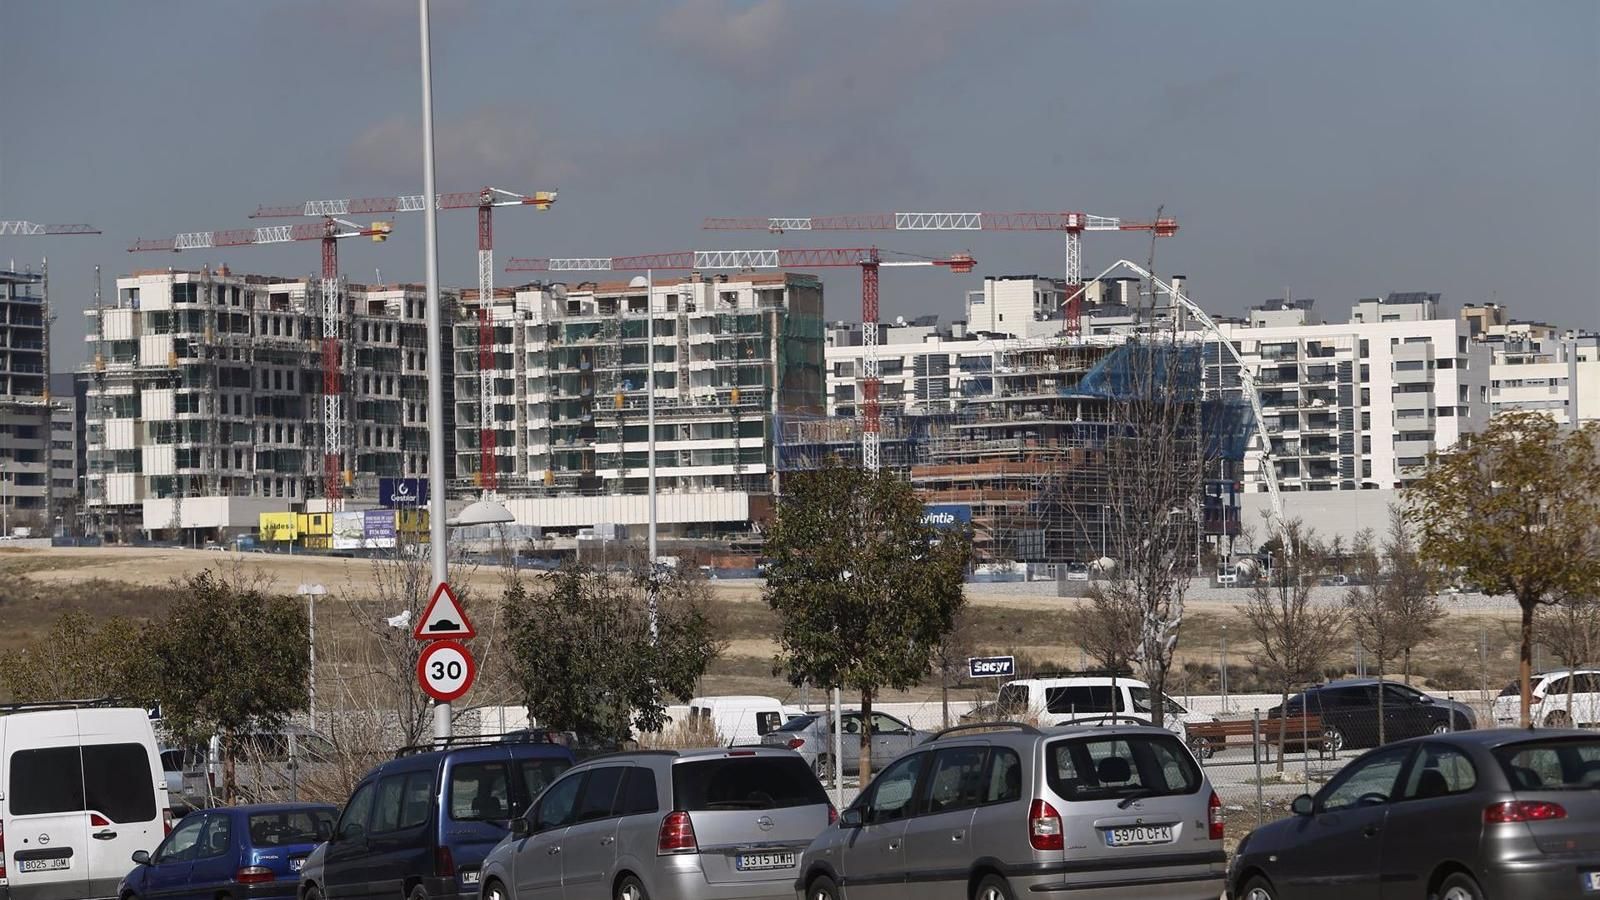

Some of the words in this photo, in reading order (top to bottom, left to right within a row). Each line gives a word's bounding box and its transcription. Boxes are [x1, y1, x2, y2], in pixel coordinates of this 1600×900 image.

[920, 512, 955, 524] vintia
[431, 661, 462, 680] 30
[973, 661, 1010, 673] Sacyr
[1114, 828, 1144, 842] 5970
[1147, 826, 1170, 840] CFK
[25, 859, 47, 870] 8025
[50, 857, 67, 868] JGM
[744, 854, 770, 866] 3315
[773, 852, 793, 864] DWH
